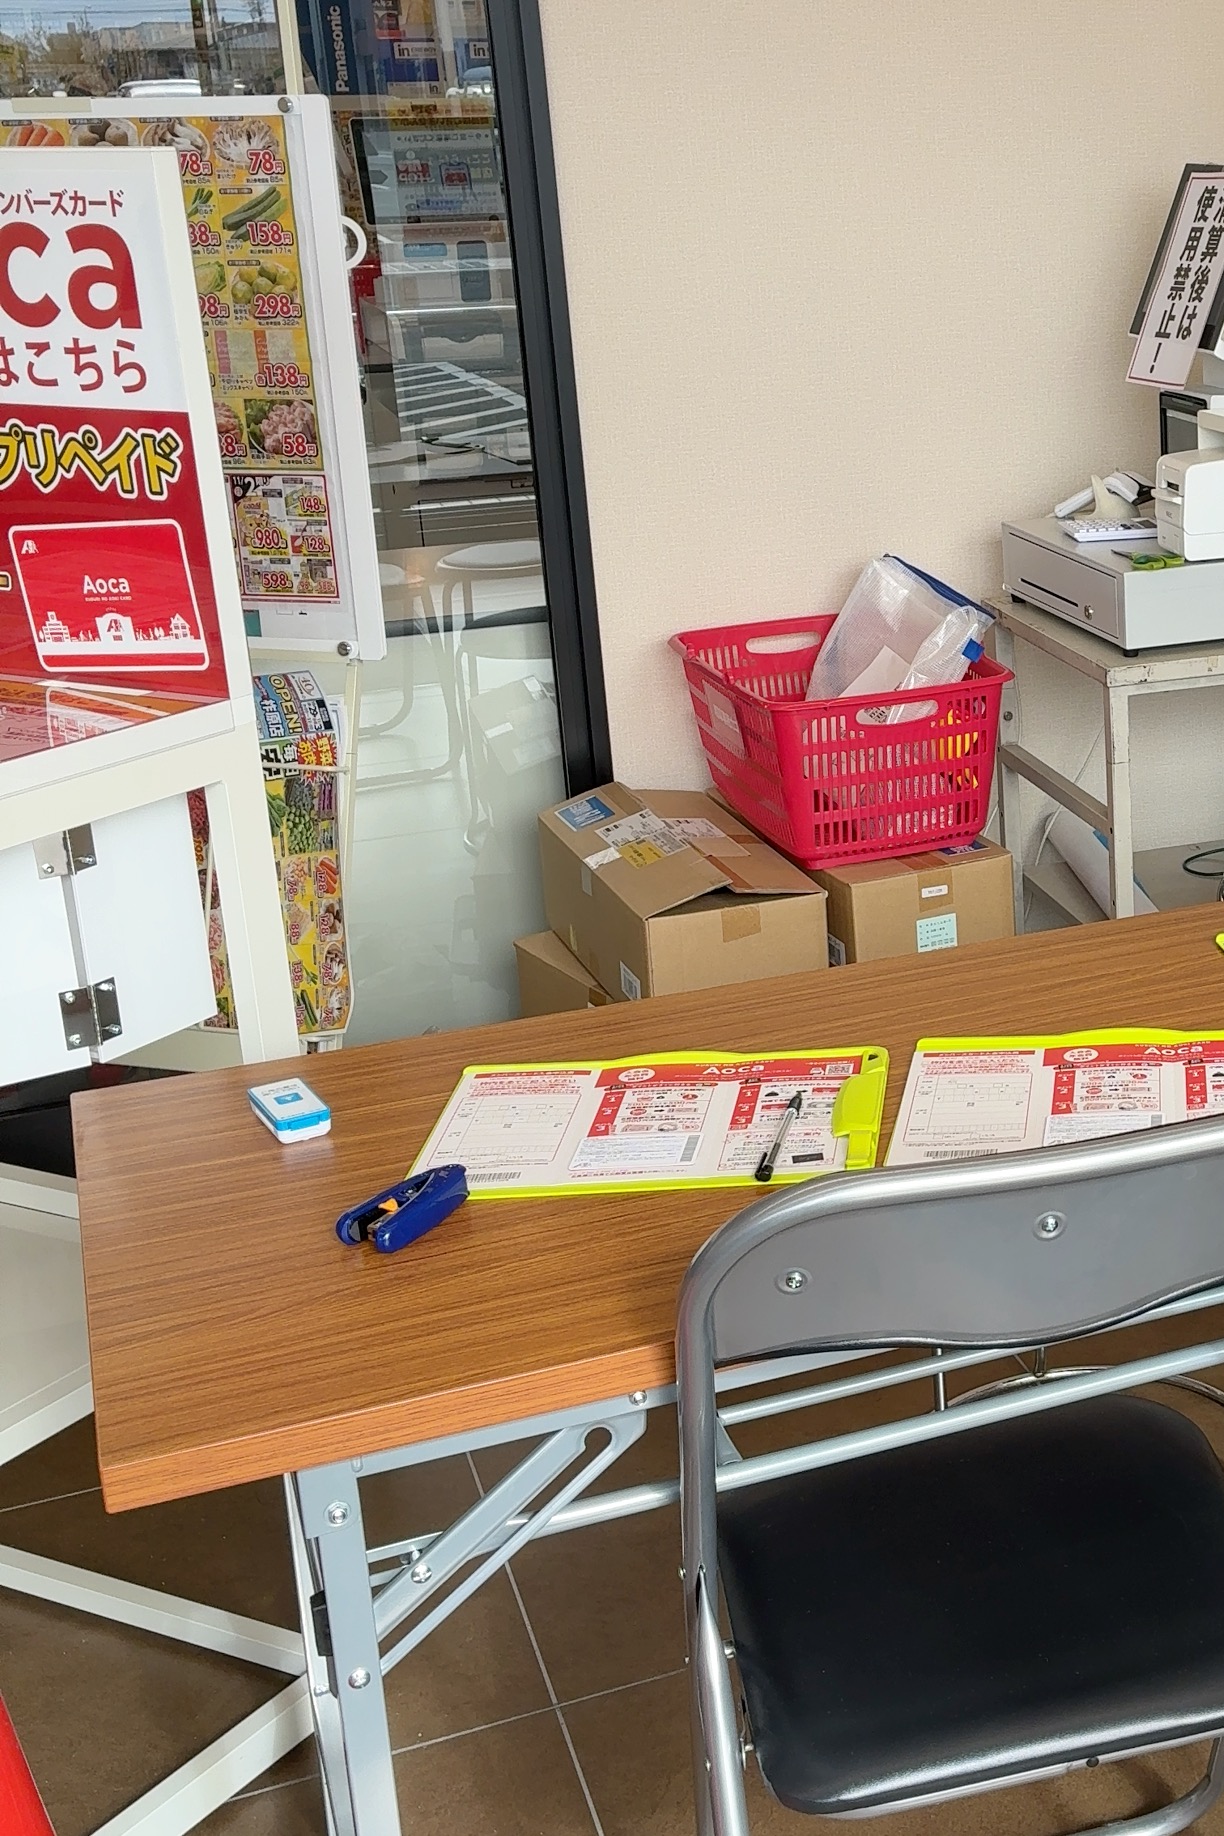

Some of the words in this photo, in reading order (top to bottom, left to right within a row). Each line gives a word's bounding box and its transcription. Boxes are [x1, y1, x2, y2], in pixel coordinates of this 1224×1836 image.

[327, 5, 350, 92] Panasonic
[248, 151, 285, 174] 78円
[247, 221, 293, 246] 158円
[255, 294, 301, 318] 298円
[282, 434, 318, 457] 58円
[83, 575, 130, 594] Aoca
[268, 674, 303, 735] OPEN!
[1143, 1045, 1204, 1056] Aoca
[702, 1063, 765, 1075] Aoca
